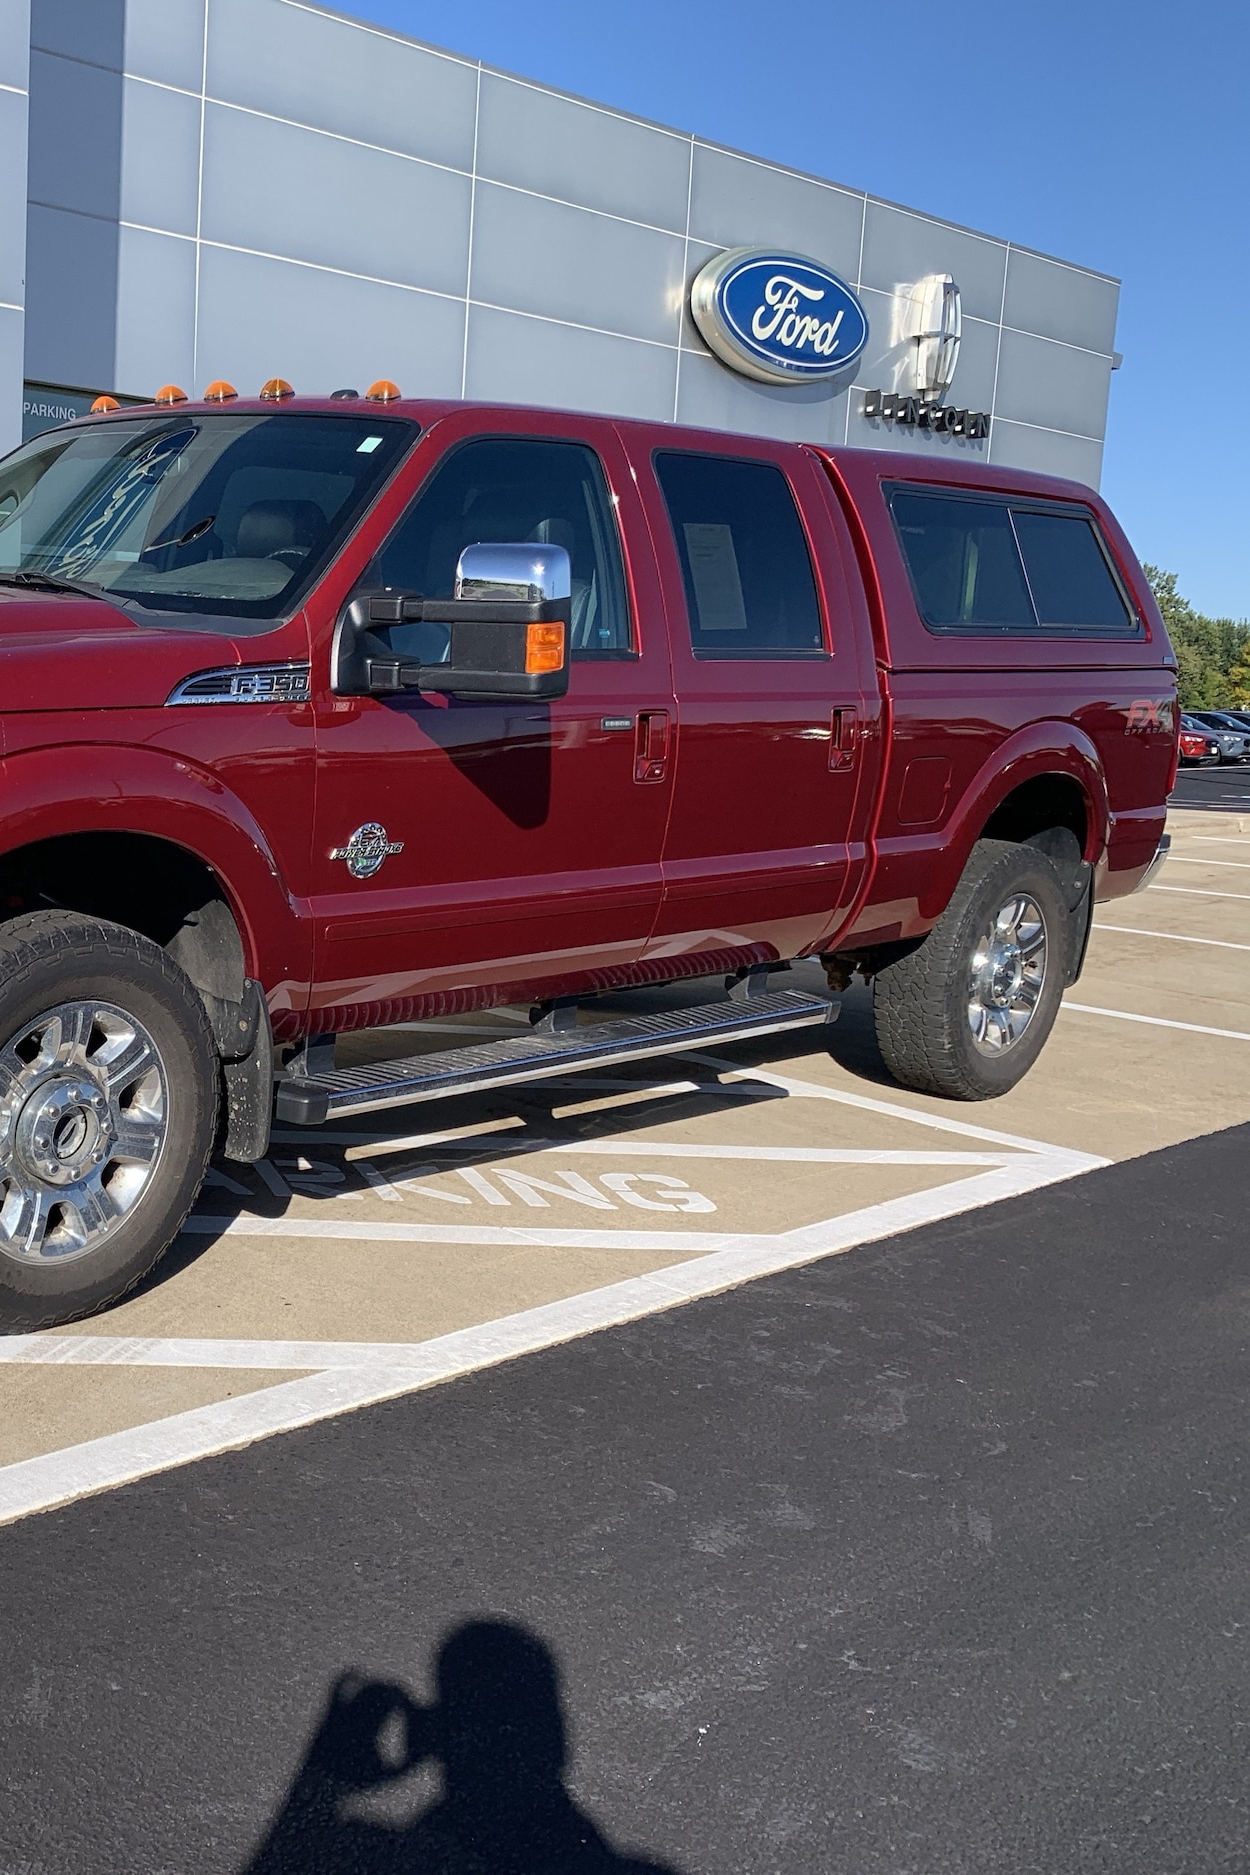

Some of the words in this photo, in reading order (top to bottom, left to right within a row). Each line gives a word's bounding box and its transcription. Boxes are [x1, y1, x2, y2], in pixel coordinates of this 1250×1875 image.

[751, 275, 845, 356] Ford
[23, 402, 76, 421] PARKING
[864, 389, 991, 439] LINCOLN
[1126, 698, 1173, 727] FX4
[206, 1158, 718, 1213] ARKING
